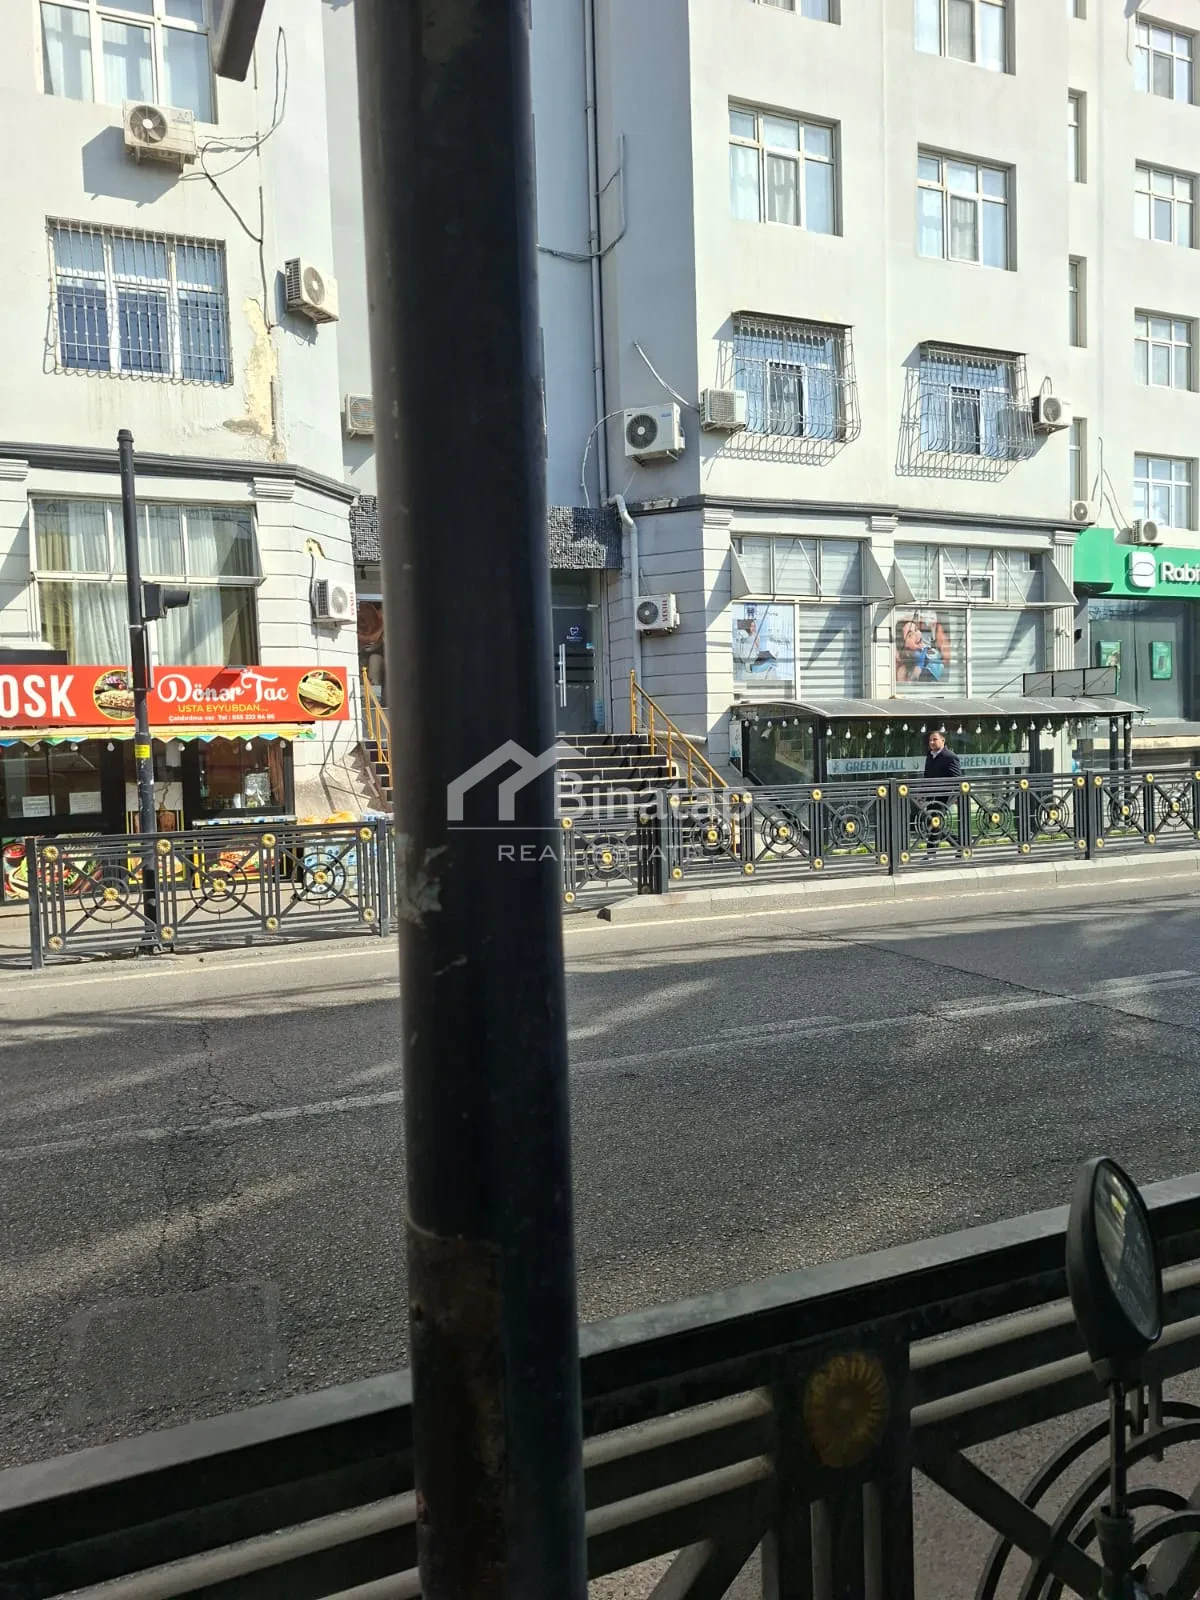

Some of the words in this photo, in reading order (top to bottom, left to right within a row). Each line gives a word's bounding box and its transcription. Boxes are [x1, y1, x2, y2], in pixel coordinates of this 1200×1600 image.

[241, 669, 289, 702] Tac
[0, 674, 77, 718] OSK
[178, 704, 204, 713] USTA
[845, 760, 878, 772] GREEN
[881, 760, 905, 770] HALL
[991, 755, 1012, 766] HALL
